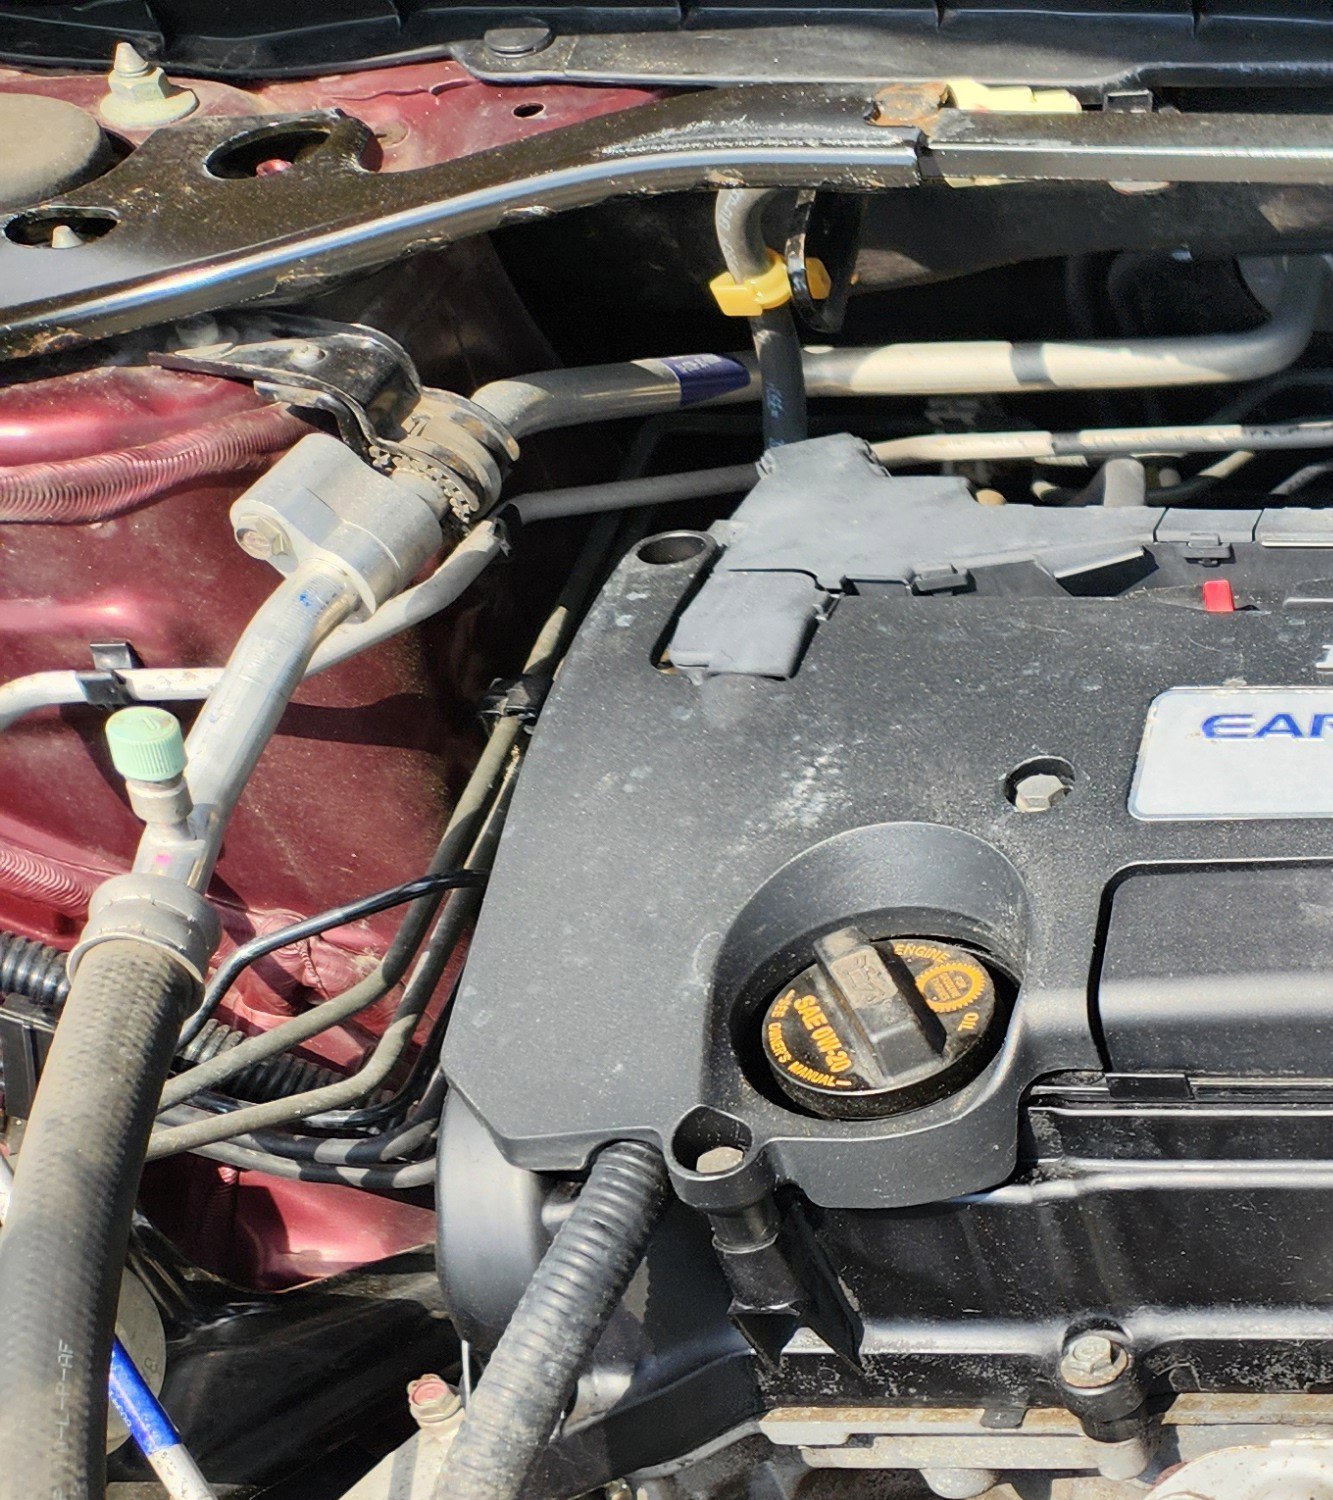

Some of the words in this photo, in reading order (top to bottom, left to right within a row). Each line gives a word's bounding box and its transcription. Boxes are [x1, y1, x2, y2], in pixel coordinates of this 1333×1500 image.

[894, 943, 952, 963] ENGINE
[794, 994, 826, 1031] SAE
[957, 1012, 980, 1032] OIL
[768, 1021, 793, 1064] OWNER'S
[787, 1061, 838, 1087] MANUAL
